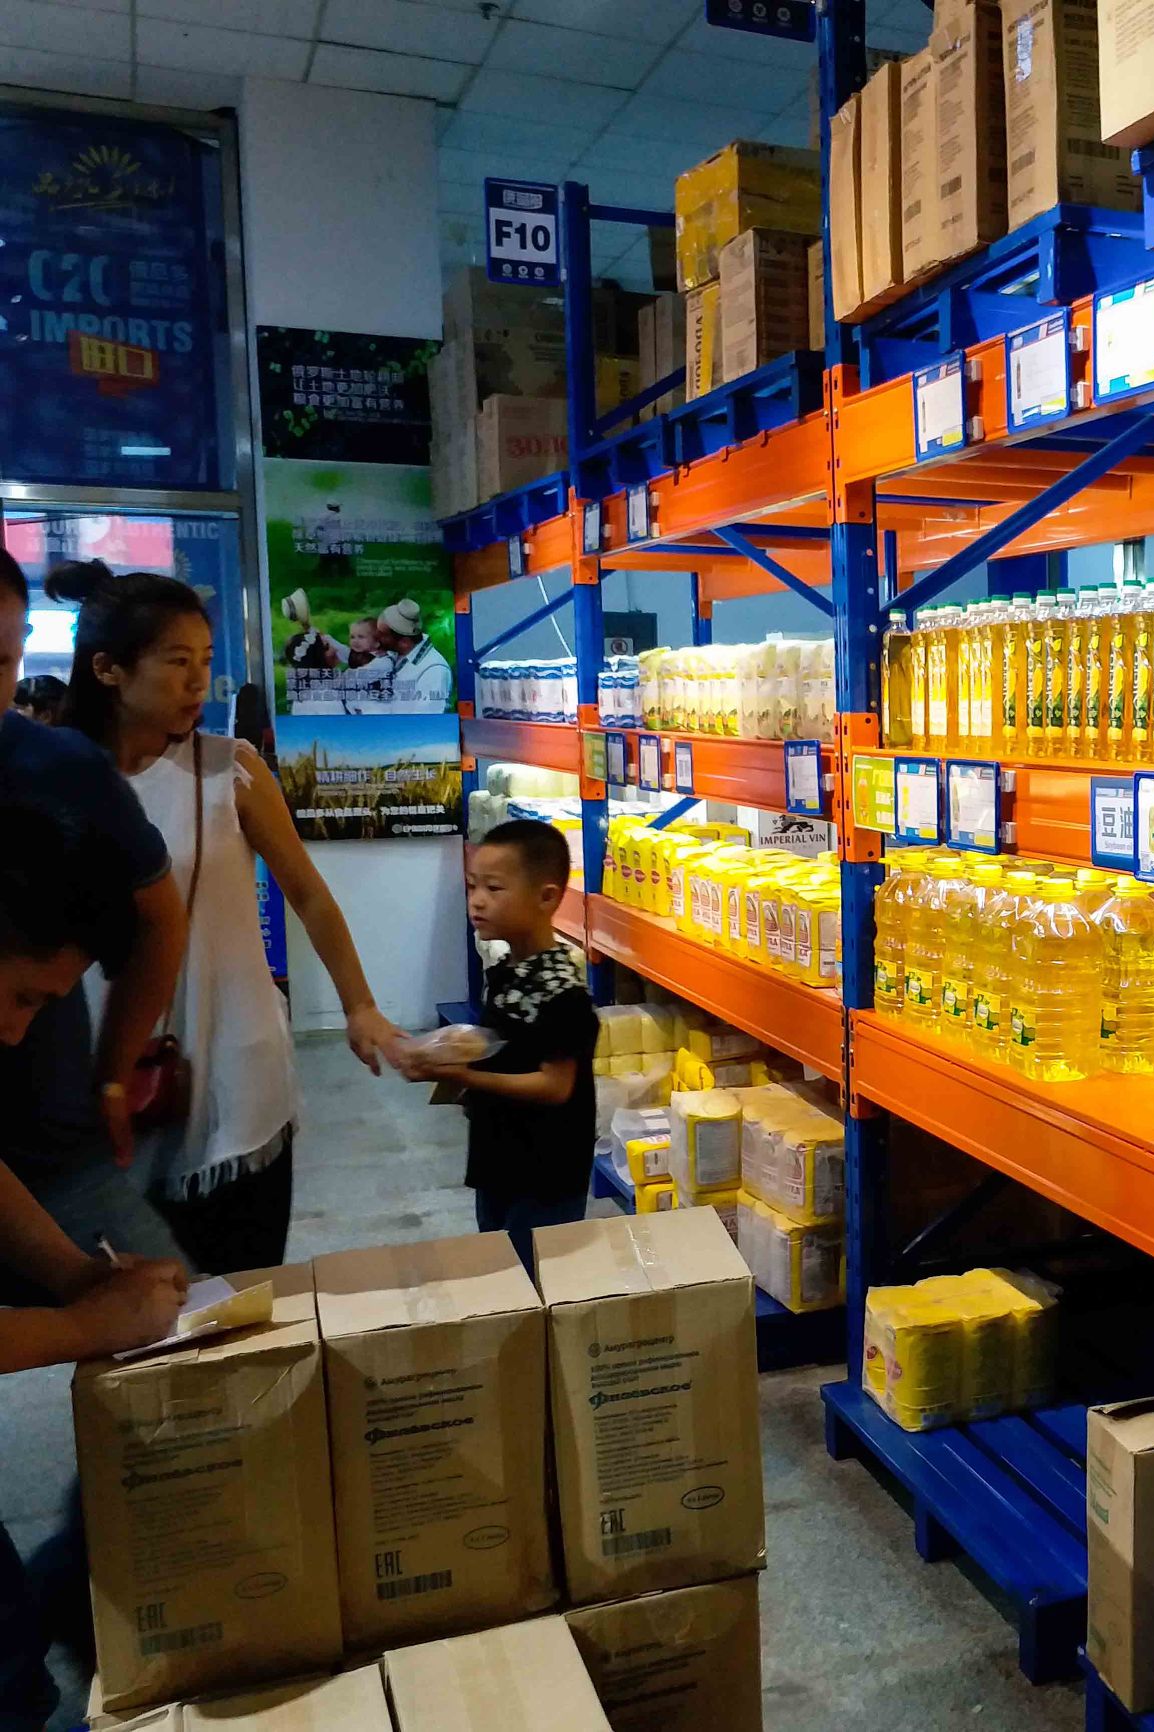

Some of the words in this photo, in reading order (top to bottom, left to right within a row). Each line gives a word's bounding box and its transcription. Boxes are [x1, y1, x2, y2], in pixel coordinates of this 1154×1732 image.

[495, 219, 551, 252] F10
[30, 309, 193, 353] IMPORTS
[1101, 806, 1134, 839] 豆油
[760, 835, 807, 846] IMPERIAL
[809, 833, 827, 843] VIN
